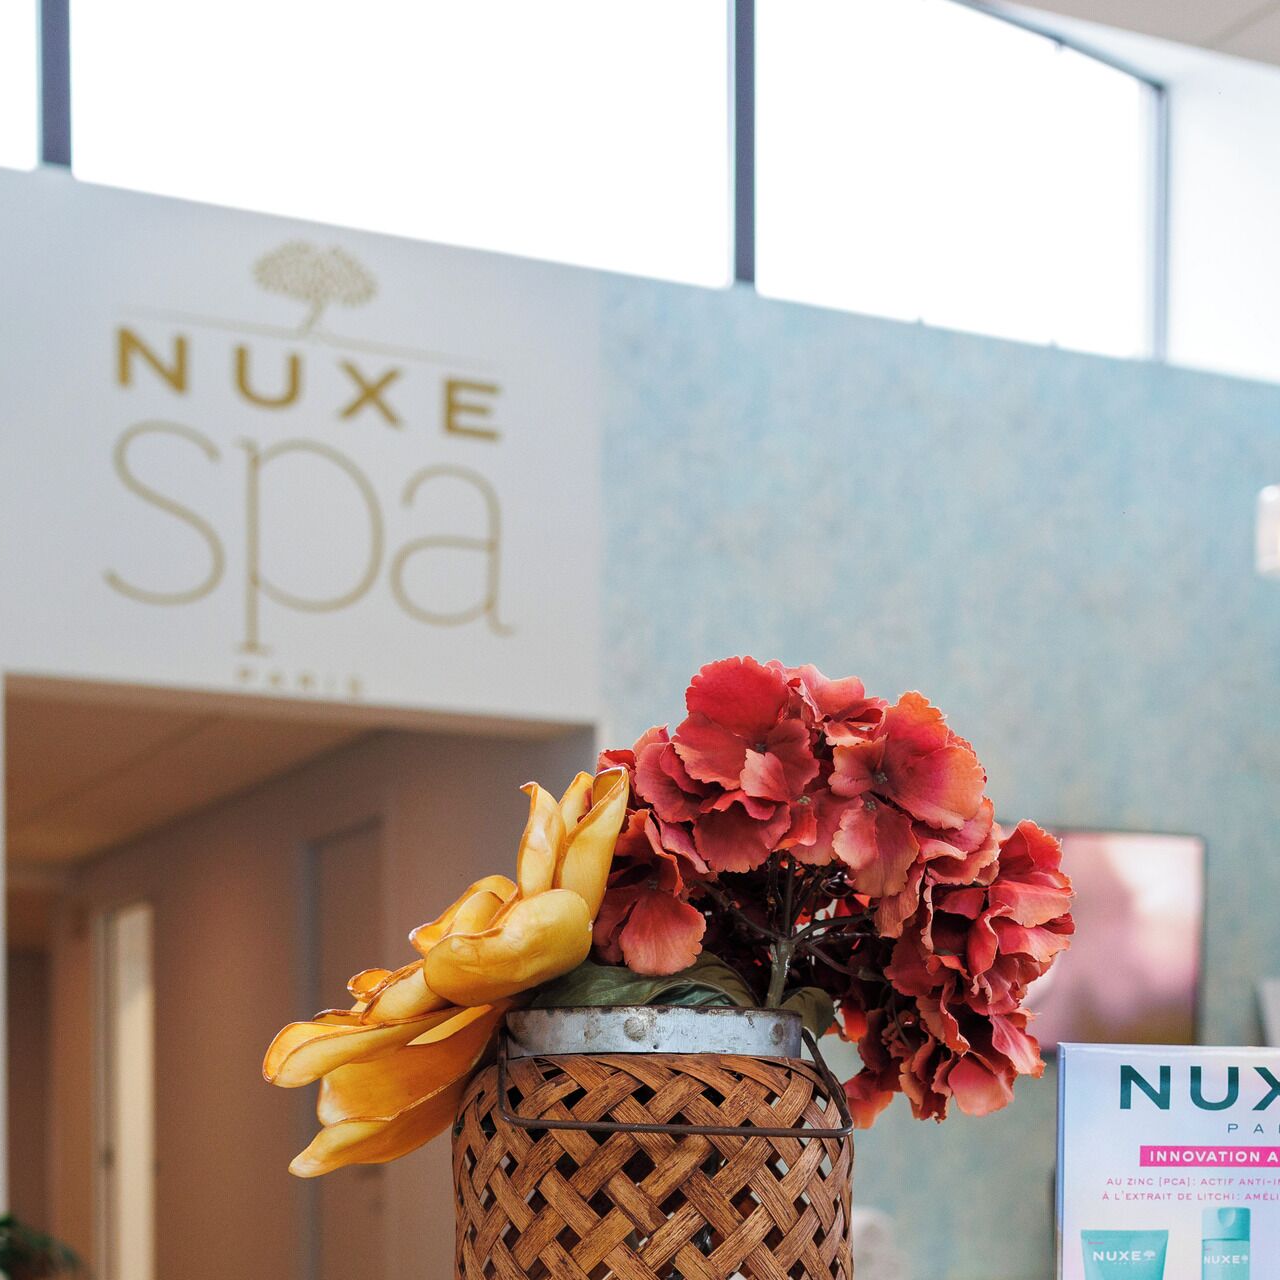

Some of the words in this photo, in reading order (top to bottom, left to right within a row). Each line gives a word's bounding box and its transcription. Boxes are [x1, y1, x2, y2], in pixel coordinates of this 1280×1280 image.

[116, 326, 500, 442] NUXE
[104, 418, 515, 655] spa
[1150, 1151, 1260, 1163] INNOVATION
[1106, 1178, 1122, 1186] AU
[1127, 1178, 1154, 1186] ZINC
[1200, 1178, 1234, 1186] ACTIF
[1177, 1192, 1192, 1201] DE
[1093, 1250, 1141, 1262] NUXE
[1204, 1255, 1240, 1264] NUXE
